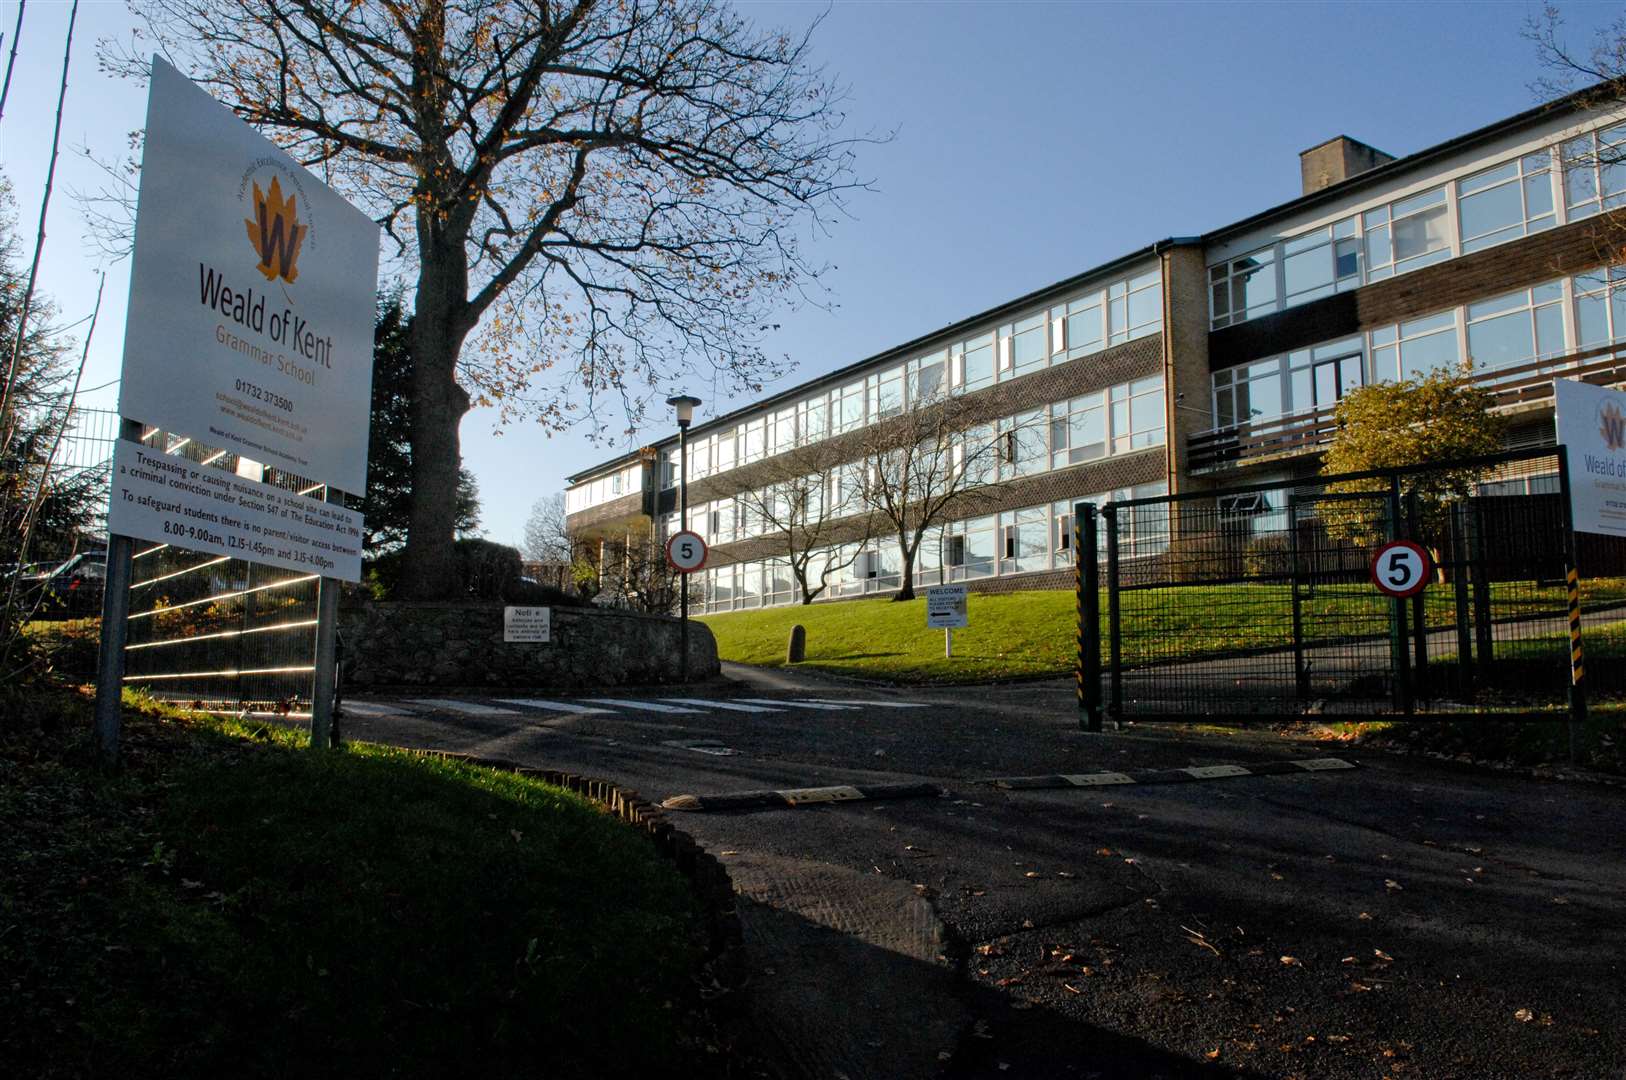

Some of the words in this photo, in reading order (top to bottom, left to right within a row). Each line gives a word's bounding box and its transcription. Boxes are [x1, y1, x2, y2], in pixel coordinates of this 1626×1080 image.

[200, 262, 264, 335] Weald
[270, 309, 291, 346] of
[293, 316, 333, 369] Kent
[216, 324, 274, 366] Grammar
[277, 354, 315, 386] School
[235, 378, 262, 400] 01732
[263, 390, 293, 413] 373500
[231, 433, 241, 443] Kent
[1584, 454, 1615, 476] Weald
[120, 466, 127, 475] a
[130, 468, 167, 485] criminal
[169, 479, 212, 498] conviction
[213, 491, 236, 503] under
[238, 495, 265, 512] Section
[267, 504, 279, 515] 547
[280, 508, 289, 518] of
[290, 510, 303, 522] The
[304, 514, 335, 531] Education
[336, 524, 347, 534] Act
[136, 451, 188, 479] Trespassing
[190, 470, 199, 480] or
[202, 474, 231, 492] causing
[233, 484, 264, 500] nuisance
[266, 493, 275, 502] on
[284, 499, 305, 511] school
[306, 504, 318, 514] site
[320, 508, 330, 518] can
[332, 511, 345, 522] lead
[345, 516, 352, 524] to
[122, 488, 134, 502] To
[137, 495, 182, 512] safeguard
[183, 508, 218, 523] students
[221, 515, 241, 529] there
[243, 520, 250, 530] is
[252, 524, 262, 534] no
[263, 528, 311, 545] parent/visitor
[311, 539, 331, 551] access
[332, 541, 357, 556] between
[163, 520, 225, 547] 8.00-9.00am,
[228, 535, 275, 557] 12.15-1.45pm
[277, 550, 292, 560] and
[294, 550, 334, 569] 3.15-4.00pm
[681, 543, 693, 559] 5
[1388, 553, 1411, 586] 5
[514, 608, 540, 616] Notie
